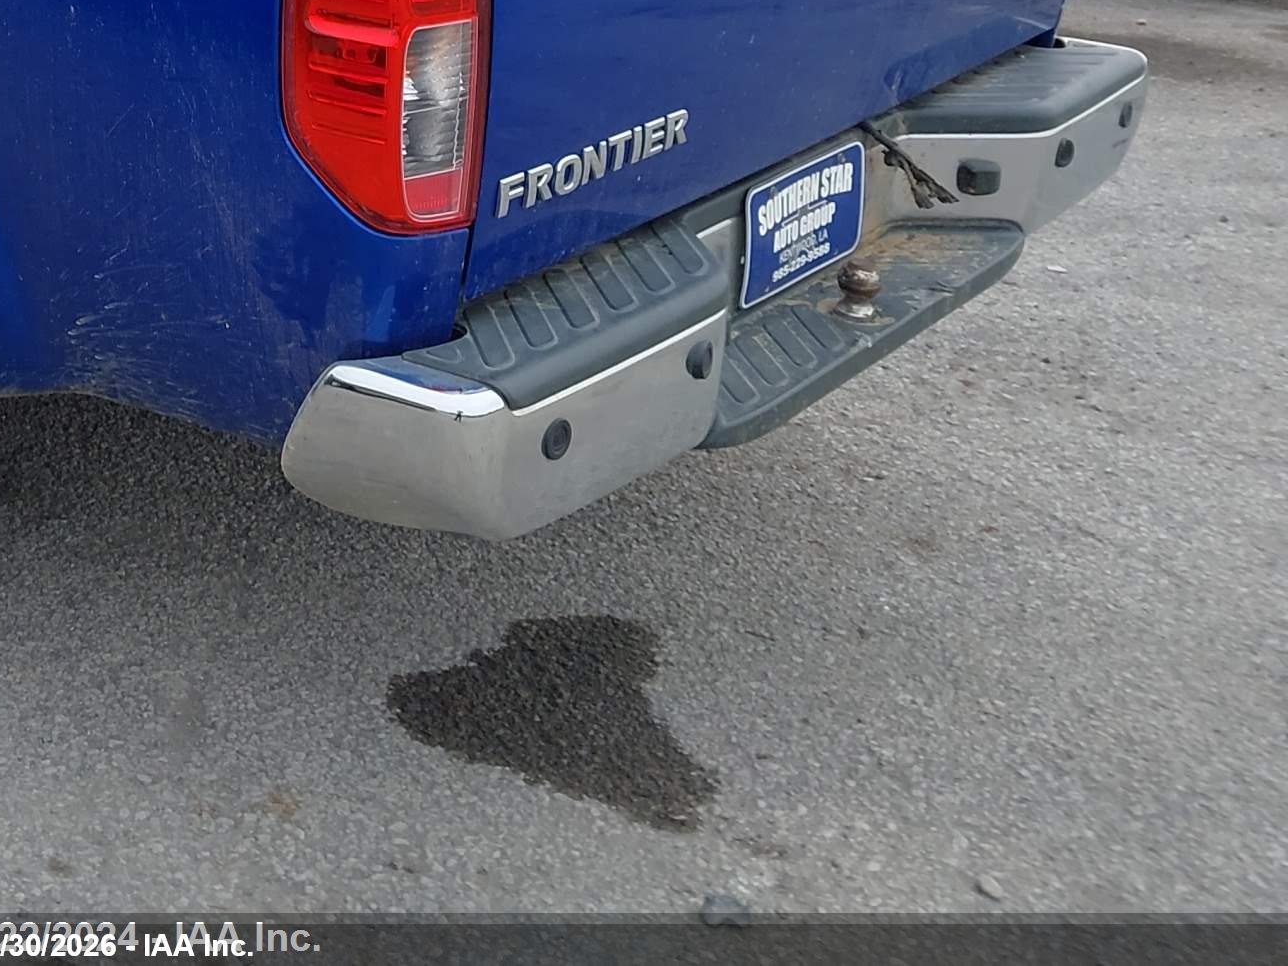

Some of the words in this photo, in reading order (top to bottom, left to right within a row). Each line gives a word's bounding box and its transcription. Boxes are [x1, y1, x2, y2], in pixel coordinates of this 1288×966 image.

[496, 108, 689, 219] FRONTIER
[757, 171, 820, 236] SOUTHERN
[820, 162, 853, 198] STAR
[773, 219, 799, 253] AUTO
[799, 201, 836, 237] GROUP
